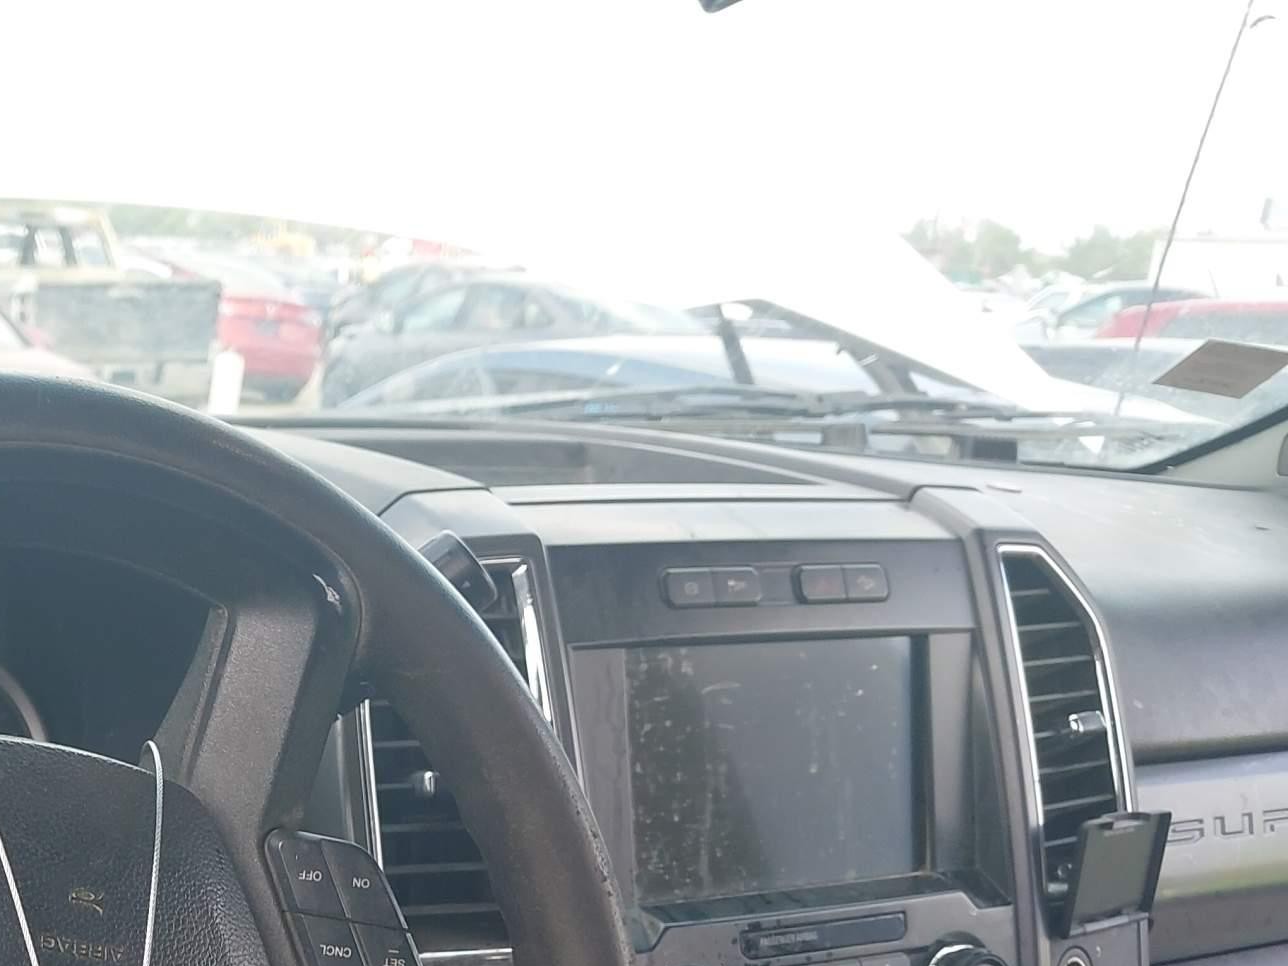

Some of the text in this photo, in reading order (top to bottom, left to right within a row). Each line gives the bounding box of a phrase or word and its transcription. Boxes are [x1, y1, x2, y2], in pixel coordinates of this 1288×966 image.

[297, 870, 322, 882] OFF
[352, 877, 370, 889] ON
[319, 943, 352, 958] CNCL
